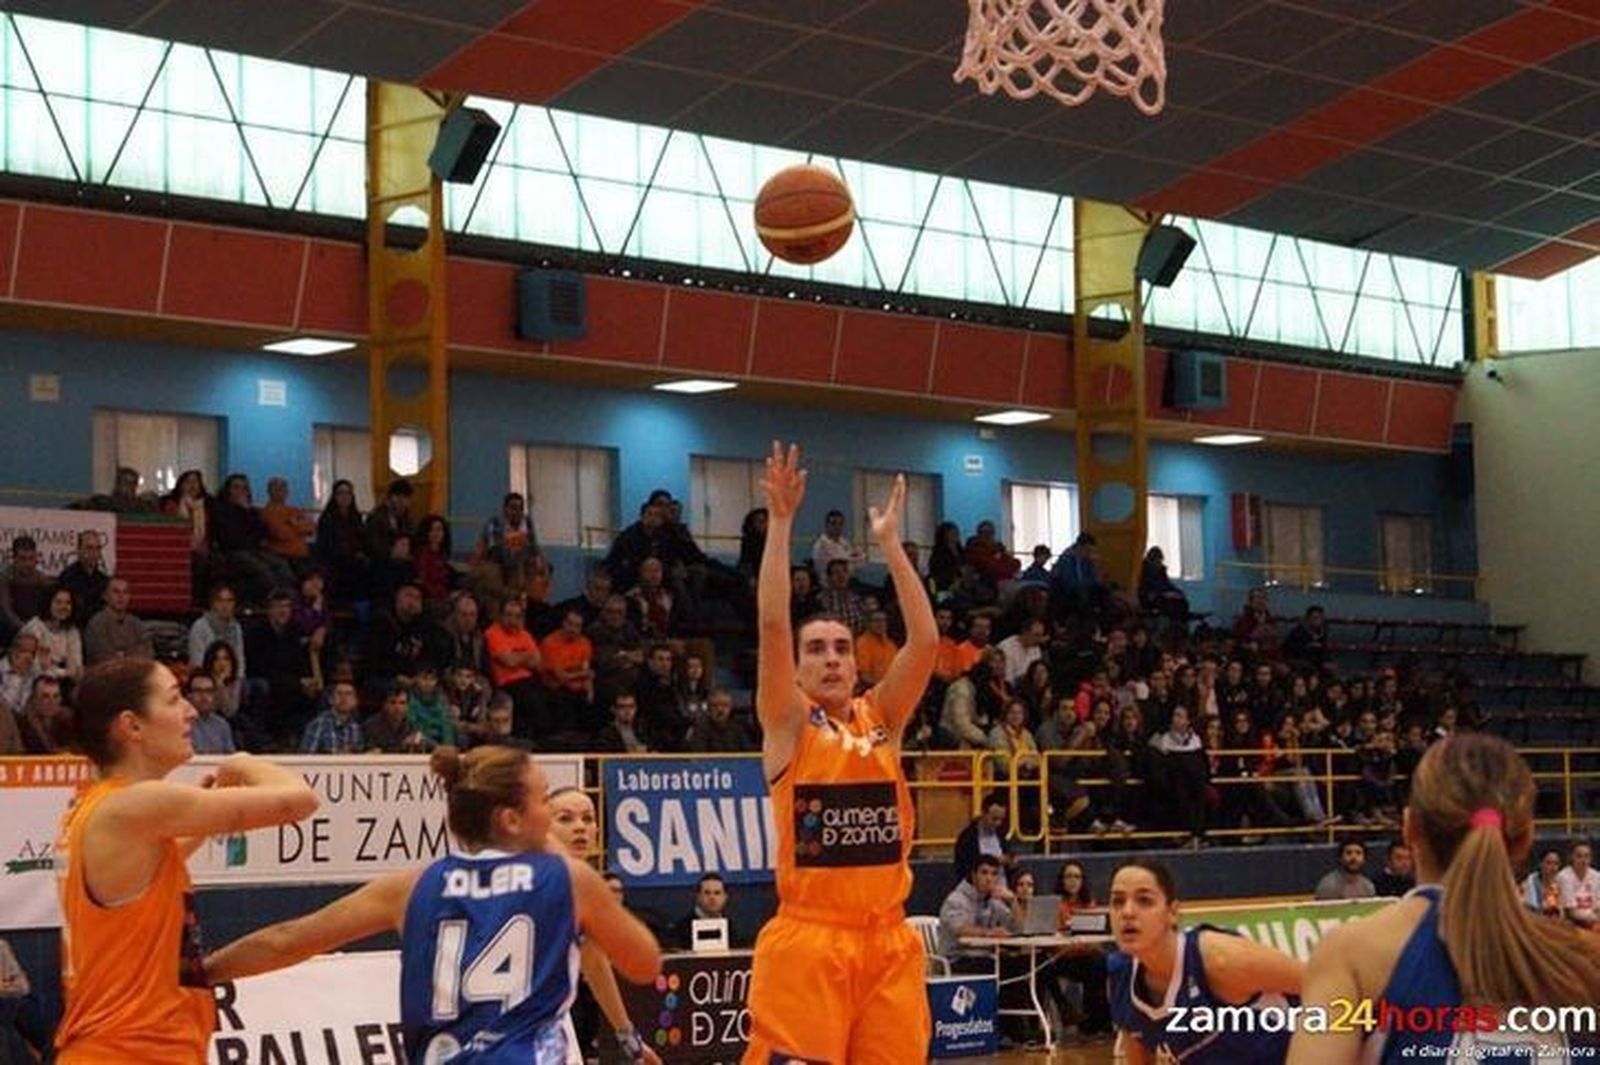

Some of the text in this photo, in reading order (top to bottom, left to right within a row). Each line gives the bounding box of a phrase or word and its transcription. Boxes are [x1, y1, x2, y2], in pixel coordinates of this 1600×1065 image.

[618, 768, 733, 791] Laboratorio
[278, 817, 451, 864] DE ZAM
[432, 913, 535, 1020] 14
